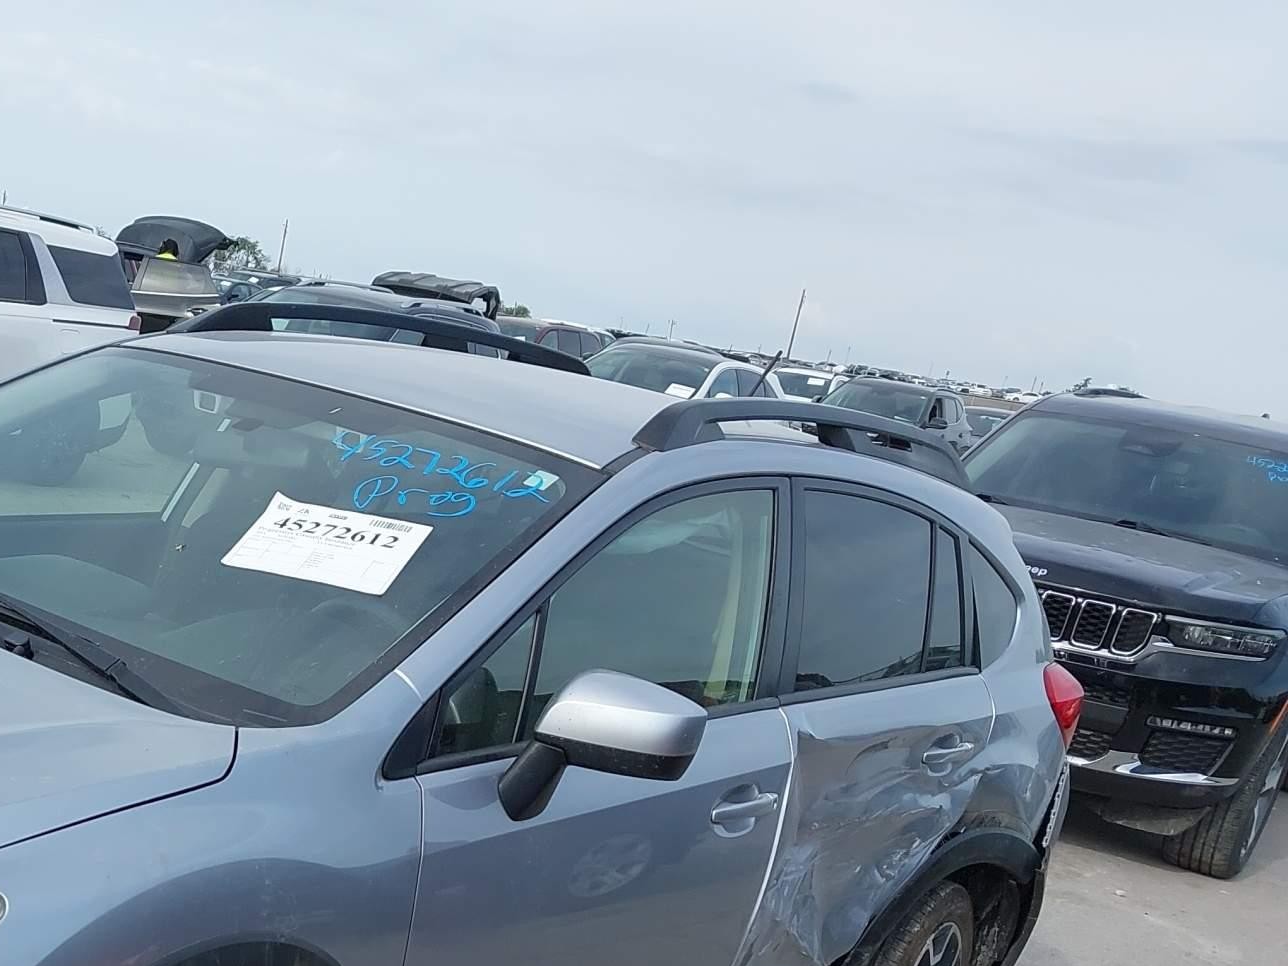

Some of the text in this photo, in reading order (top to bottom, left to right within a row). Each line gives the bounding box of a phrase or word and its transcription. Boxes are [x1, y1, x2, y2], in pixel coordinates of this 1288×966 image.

[331, 430, 551, 504] 45272612
[353, 475, 477, 518] Prog
[273, 517, 400, 549] 45272612
